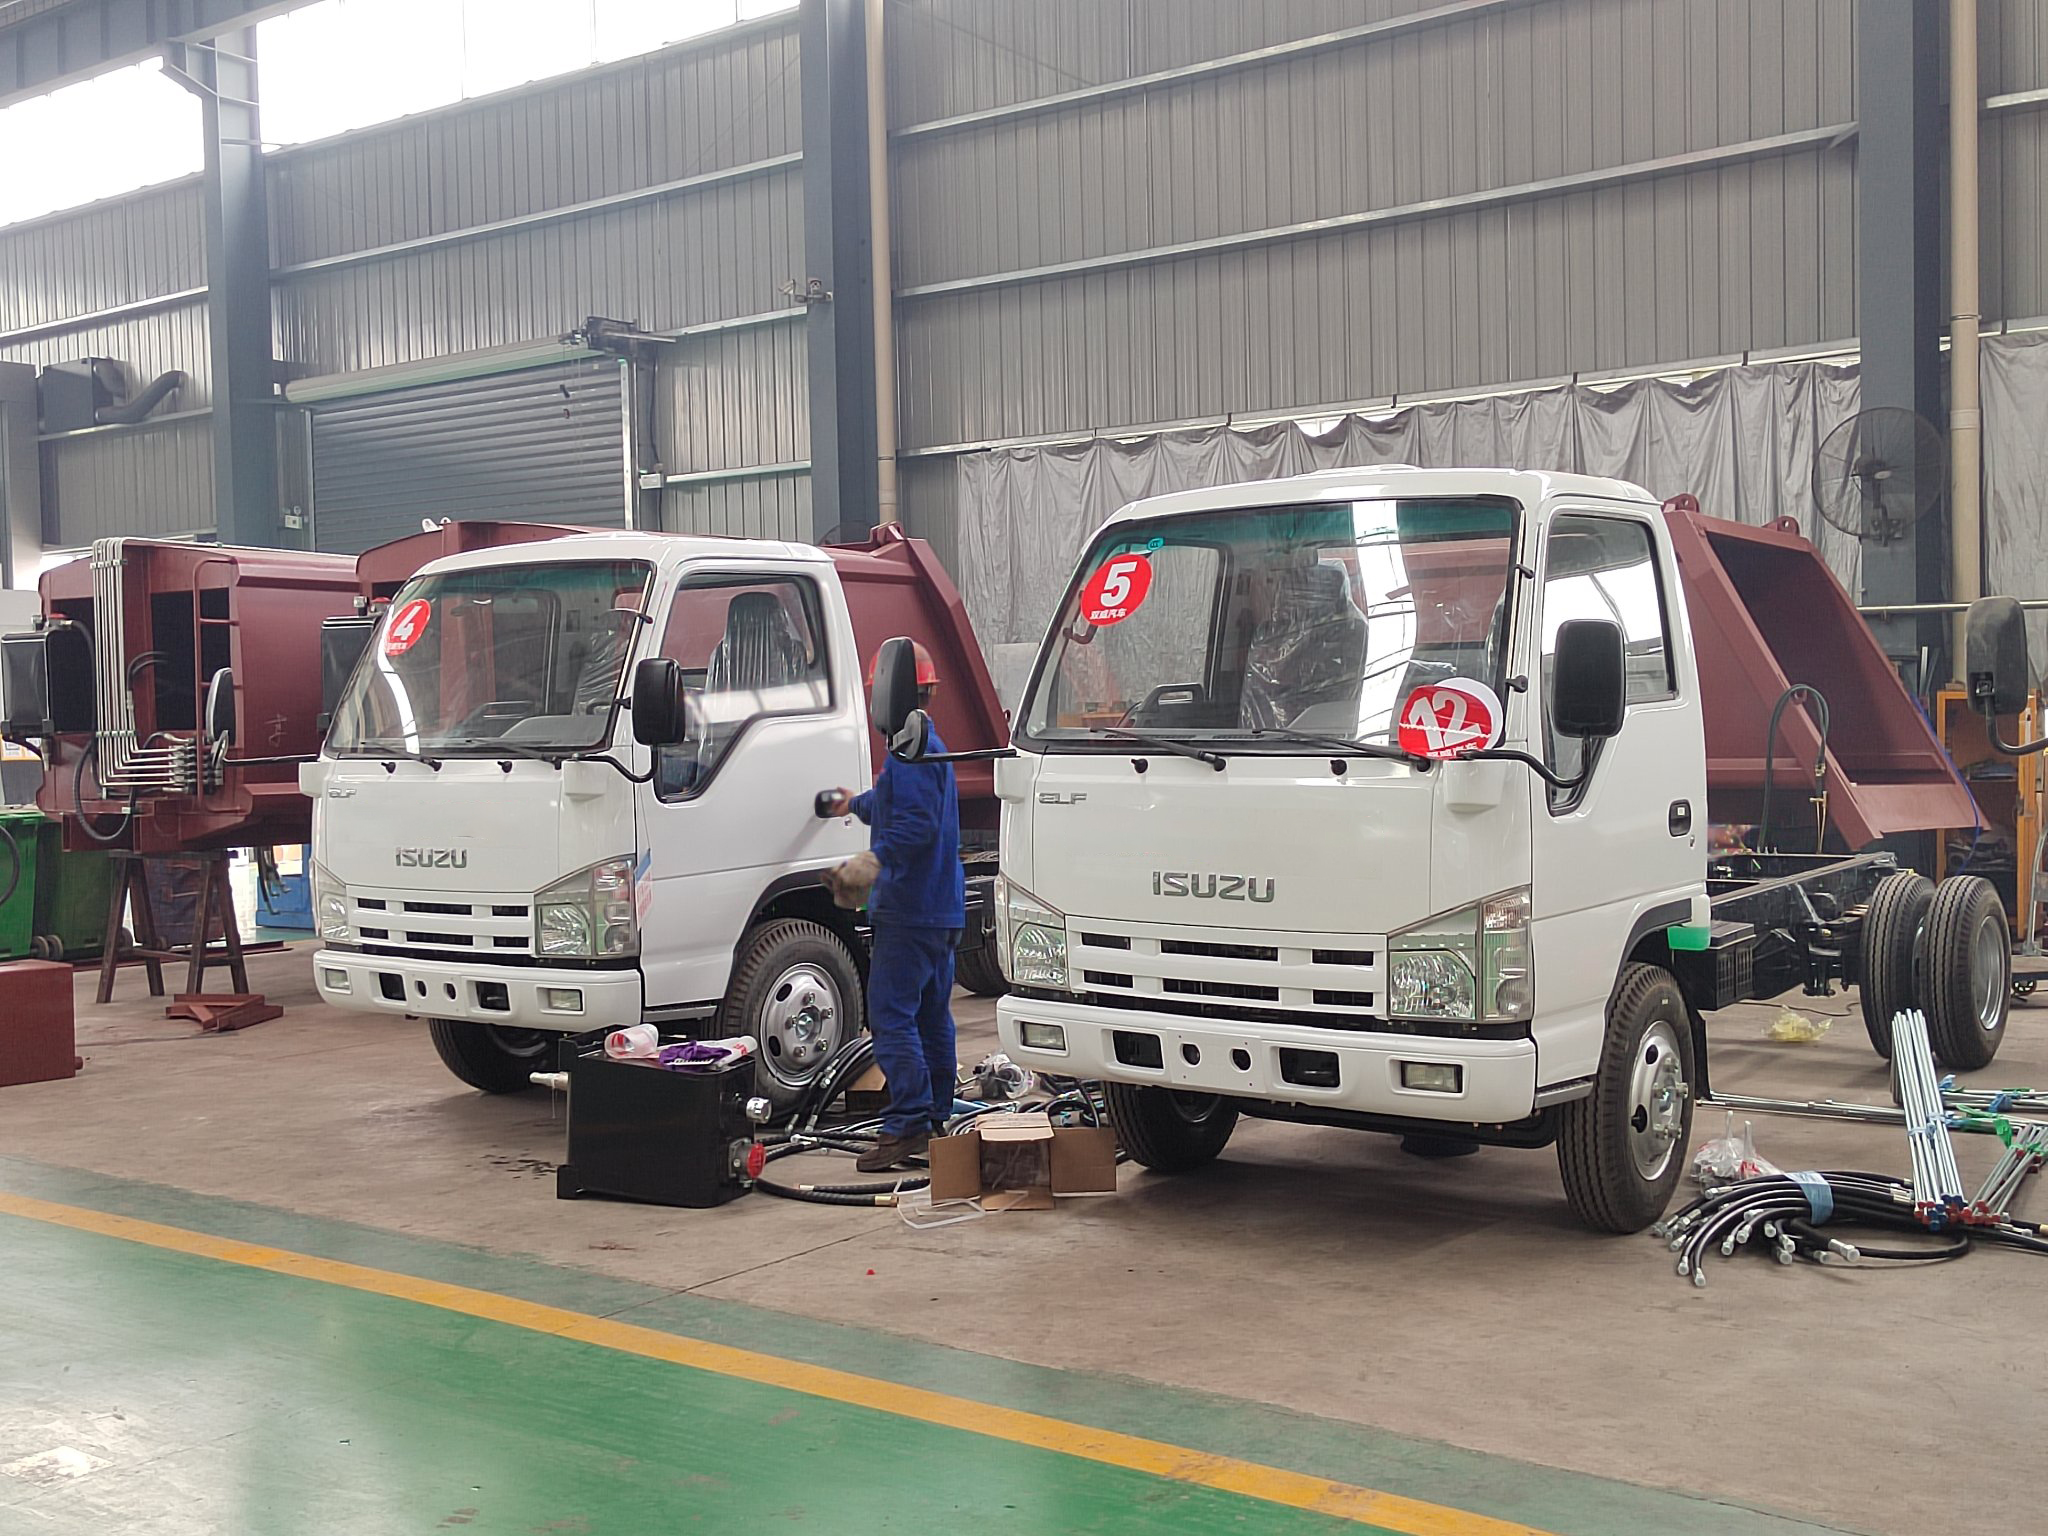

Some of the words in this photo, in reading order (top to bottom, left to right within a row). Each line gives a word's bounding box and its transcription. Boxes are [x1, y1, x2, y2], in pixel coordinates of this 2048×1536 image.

[1100, 561, 1138, 608] 5
[393, 605, 423, 641] 4
[1408, 690, 1482, 750] 12
[1039, 792, 1087, 805] ELF
[395, 847, 468, 869] ISUZU
[1152, 871, 1275, 903] ISUZU
